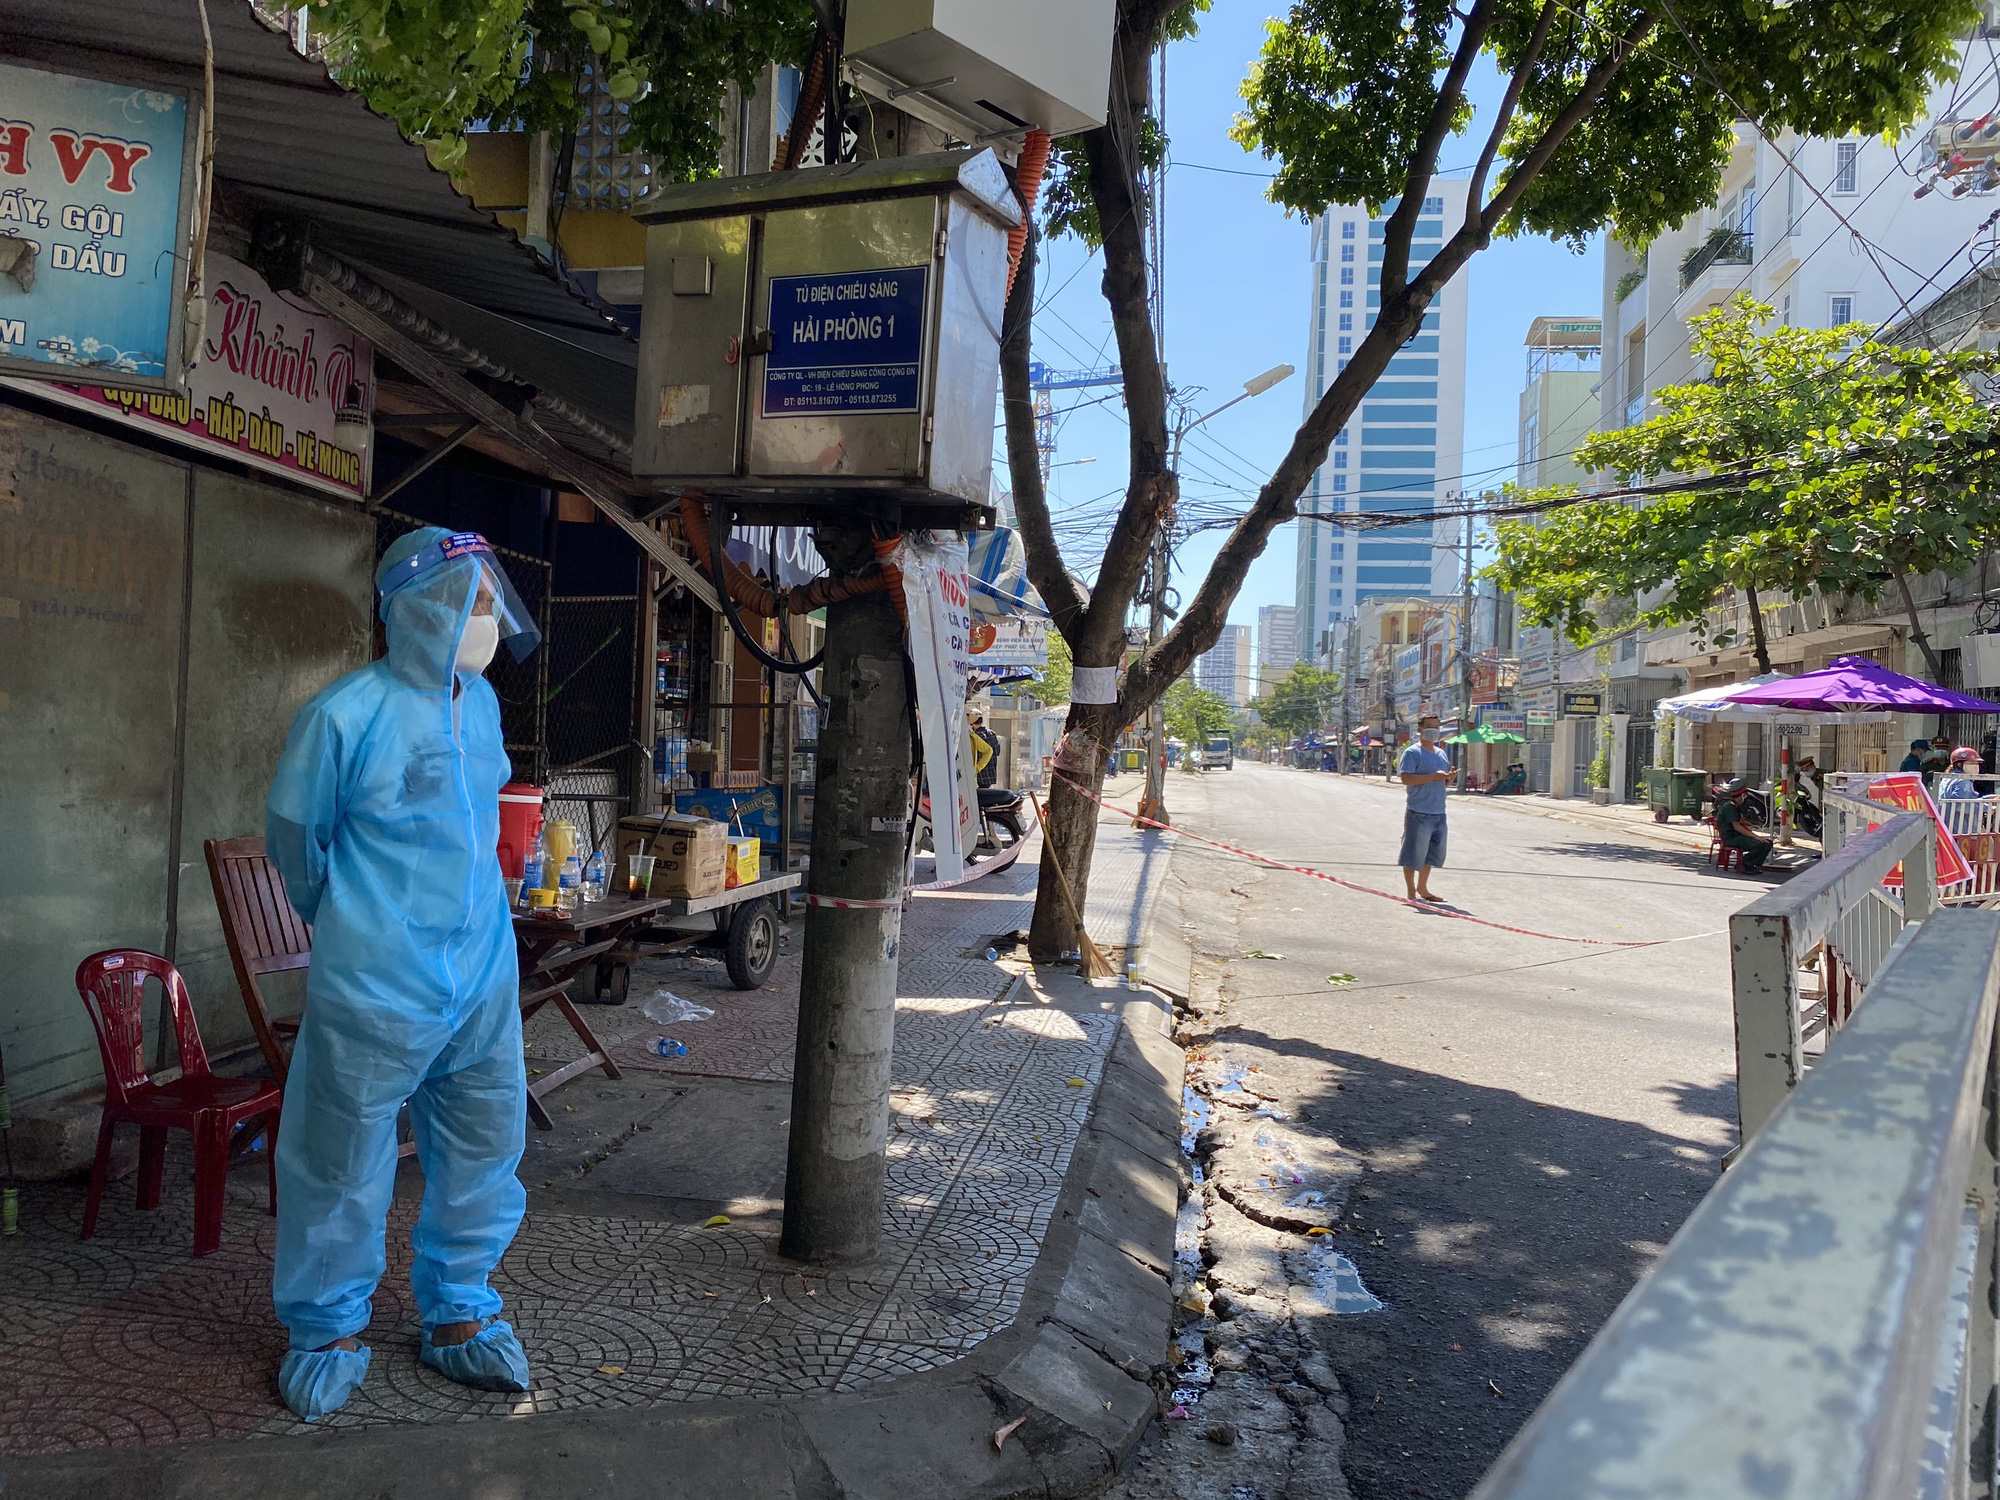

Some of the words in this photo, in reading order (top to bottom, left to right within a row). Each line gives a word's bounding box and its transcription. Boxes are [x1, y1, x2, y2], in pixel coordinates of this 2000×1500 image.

[50, 127, 152, 193] VY
[61, 204, 124, 239] GỘI
[52, 241, 127, 277] DẦU
[796, 284, 809, 303] TỦ
[811, 283, 834, 305] ĐIỆN
[837, 280, 867, 300] CHIẾU
[869, 278, 898, 299] SÁNG
[793, 315, 820, 343] HẢI
[824, 311, 882, 341] PHÒNG
[888, 315, 895, 338] 1
[770, 371, 786, 381] CÔNG
[787, 371, 795, 380] TY
[795, 371, 804, 380] QL
[808, 370, 816, 379] VH
[817, 369, 831, 381] ĐIỆN
[850, 368, 867, 378] SÁNG
[869, 367, 886, 377] CÔNG
[802, 384, 813, 392] ĐC:
[826, 382, 835, 391] LÊ
[855, 382, 879, 390] PHONG
[784, 397, 795, 406] ĐT:
[208, 391, 246, 445] HẤP
[248, 406, 284, 459] DẦU
